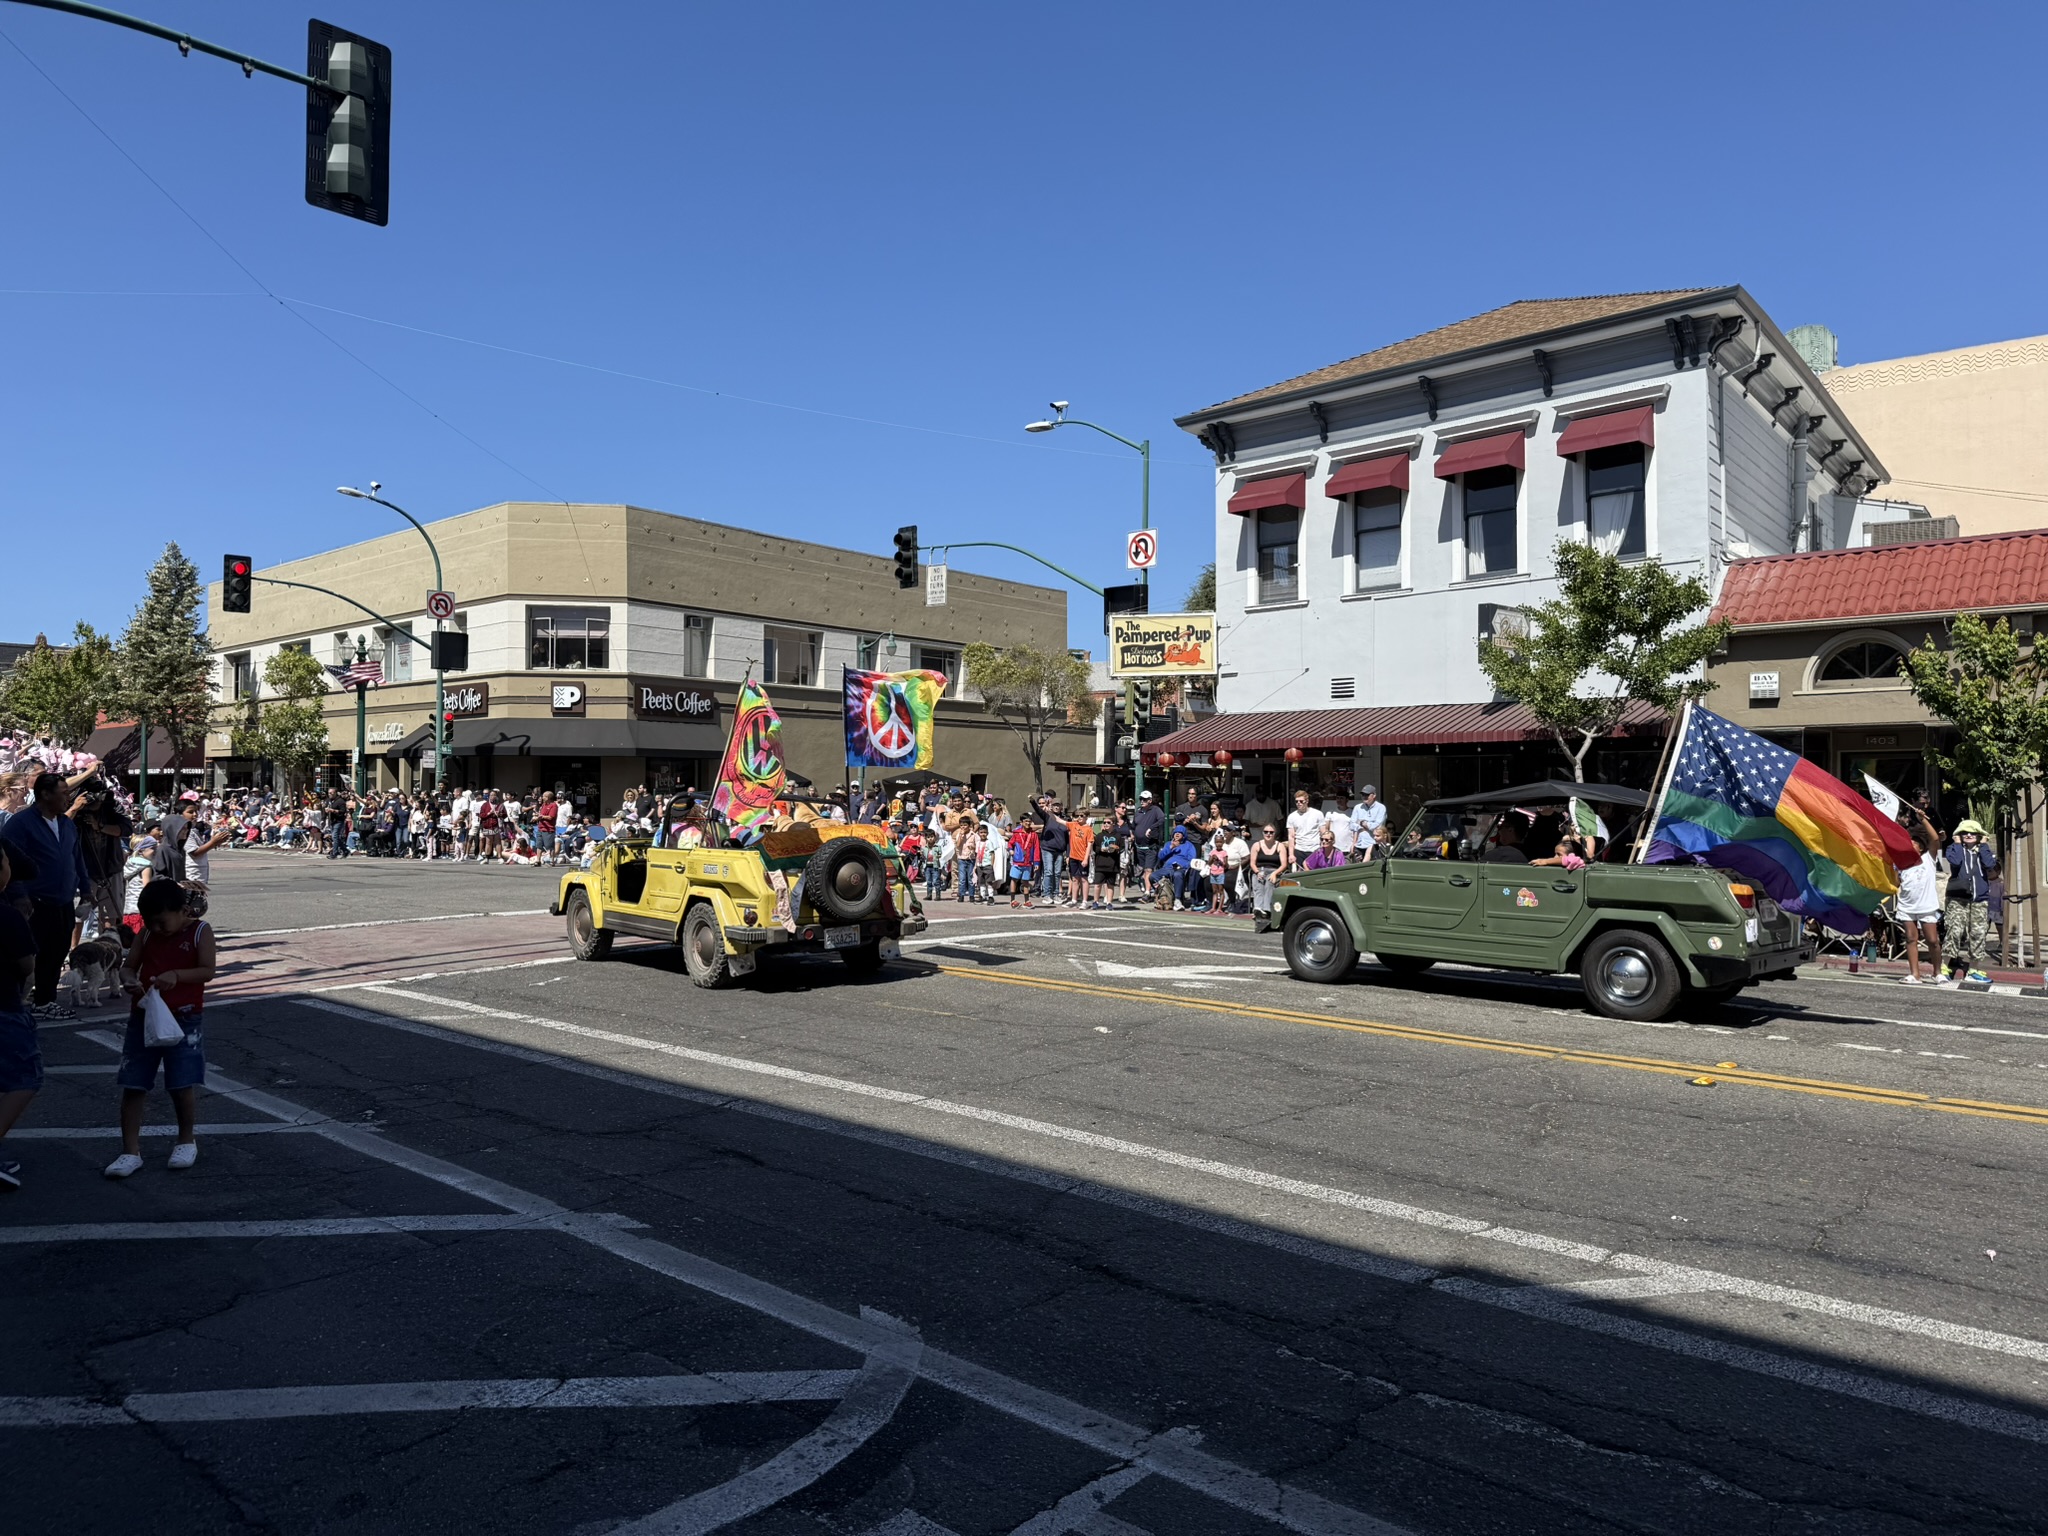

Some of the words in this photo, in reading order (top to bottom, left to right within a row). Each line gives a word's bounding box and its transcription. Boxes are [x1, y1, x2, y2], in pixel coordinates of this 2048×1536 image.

[930, 574, 944, 582] LEFT
[930, 582, 944, 590] TURN
[1126, 620, 1141, 631] The
[1115, 626, 1180, 644] Pampered
[1186, 624, 1212, 643] Pup
[1130, 646, 1158, 655] Deluxe
[1124, 651, 1141, 665] HOT
[1141, 650, 1163, 664] DOGS
[459, 687, 482, 712] Coffee
[553, 686, 582, 708] P
[674, 691, 711, 715] Coffee
[1866, 737, 1896, 745] 1403
